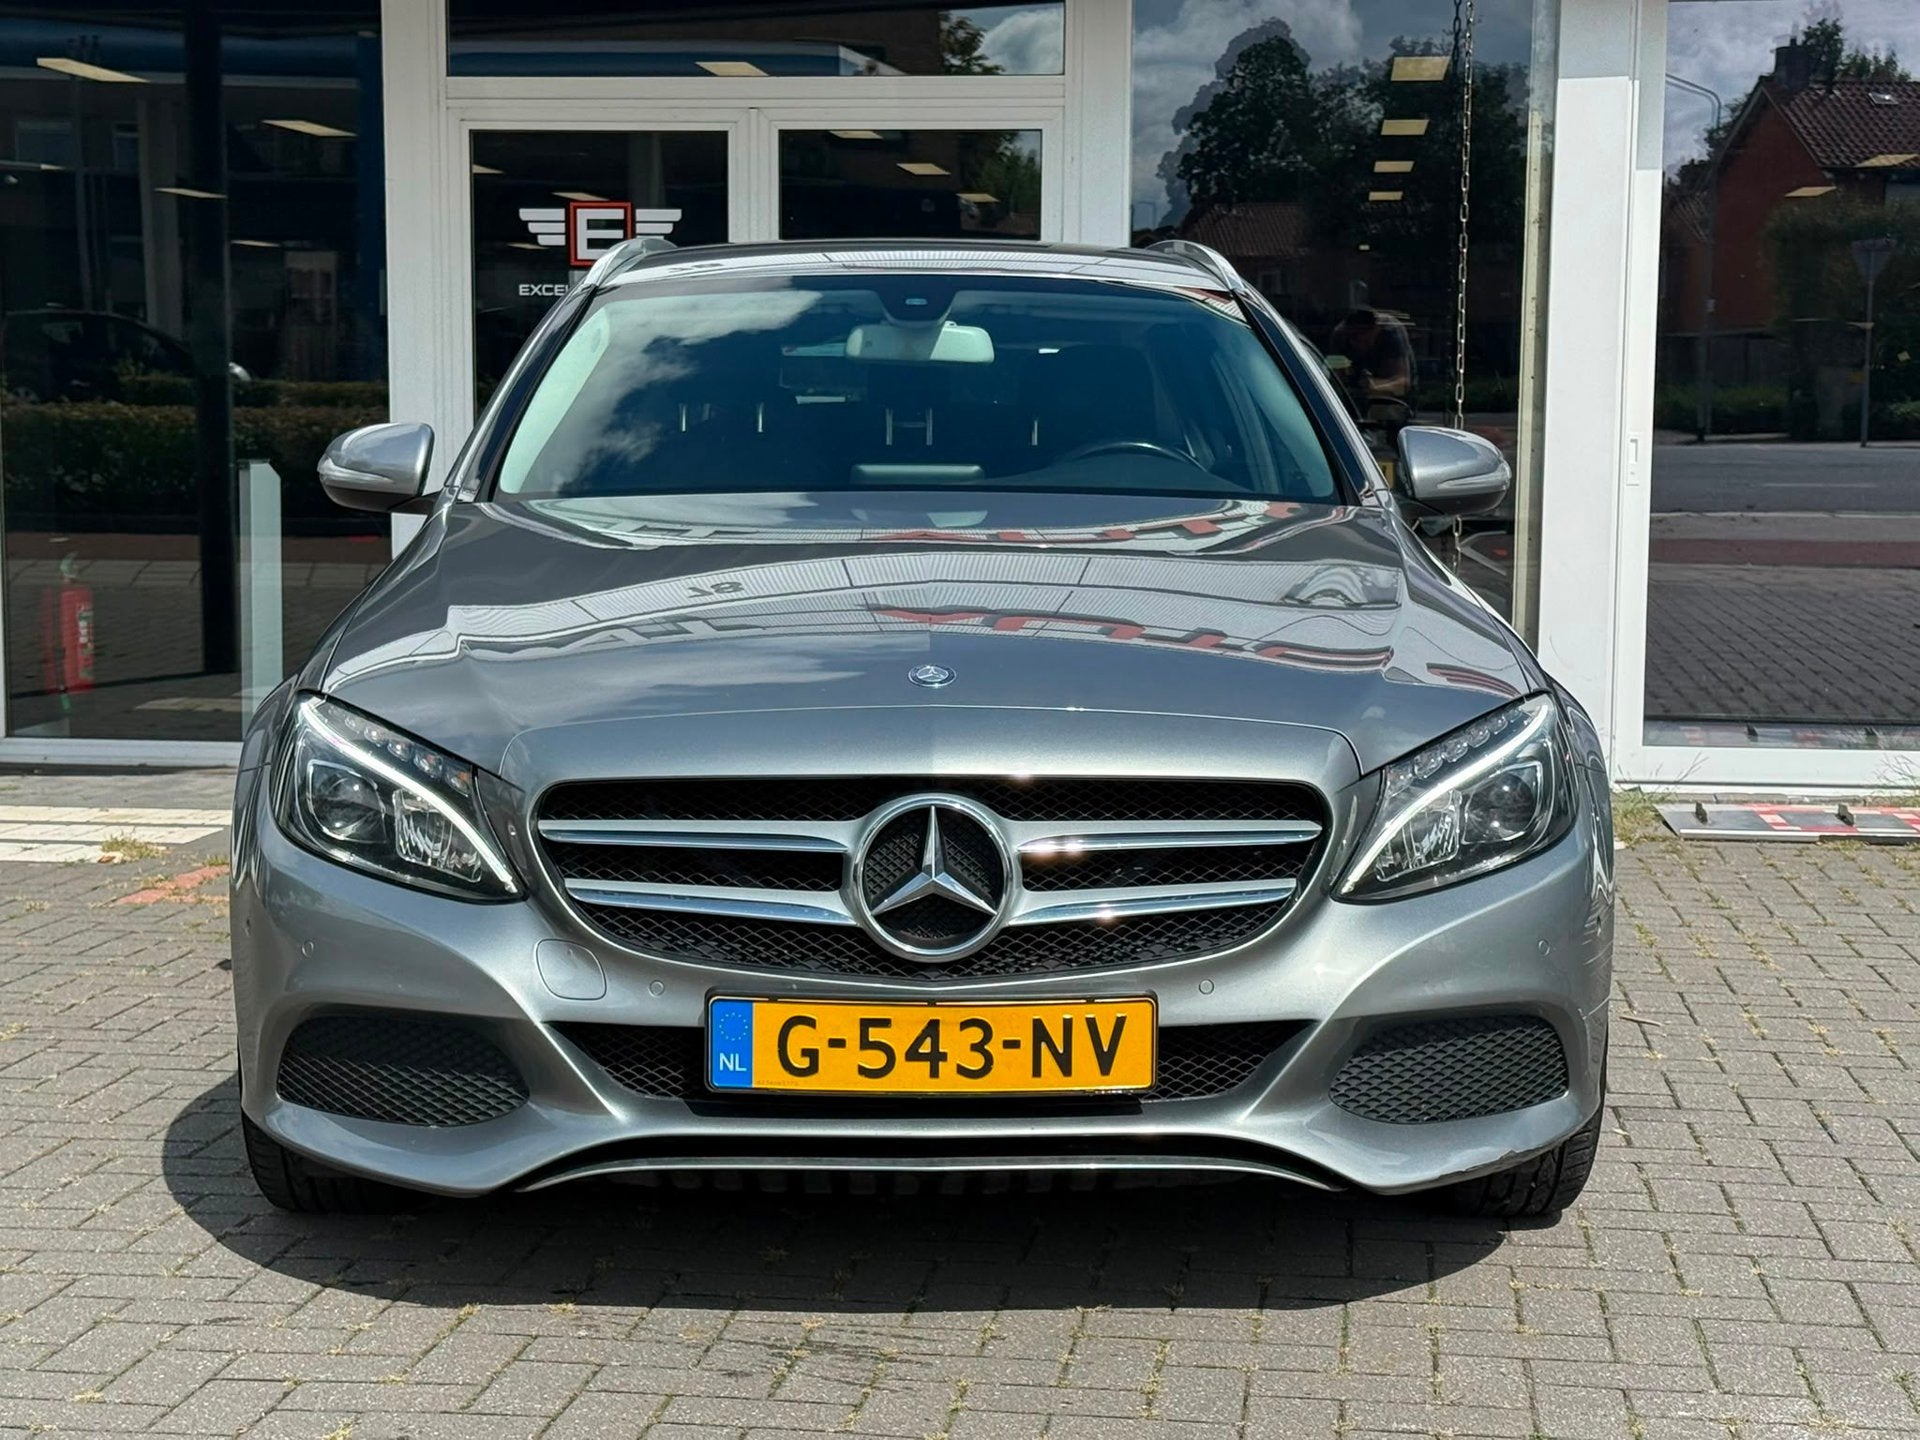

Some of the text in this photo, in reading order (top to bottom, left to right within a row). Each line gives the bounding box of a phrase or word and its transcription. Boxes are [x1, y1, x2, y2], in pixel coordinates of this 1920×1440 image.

[576, 208, 625, 260] E
[719, 1053, 747, 1072] NL
[777, 1014, 1127, 1080] G-543-NV
